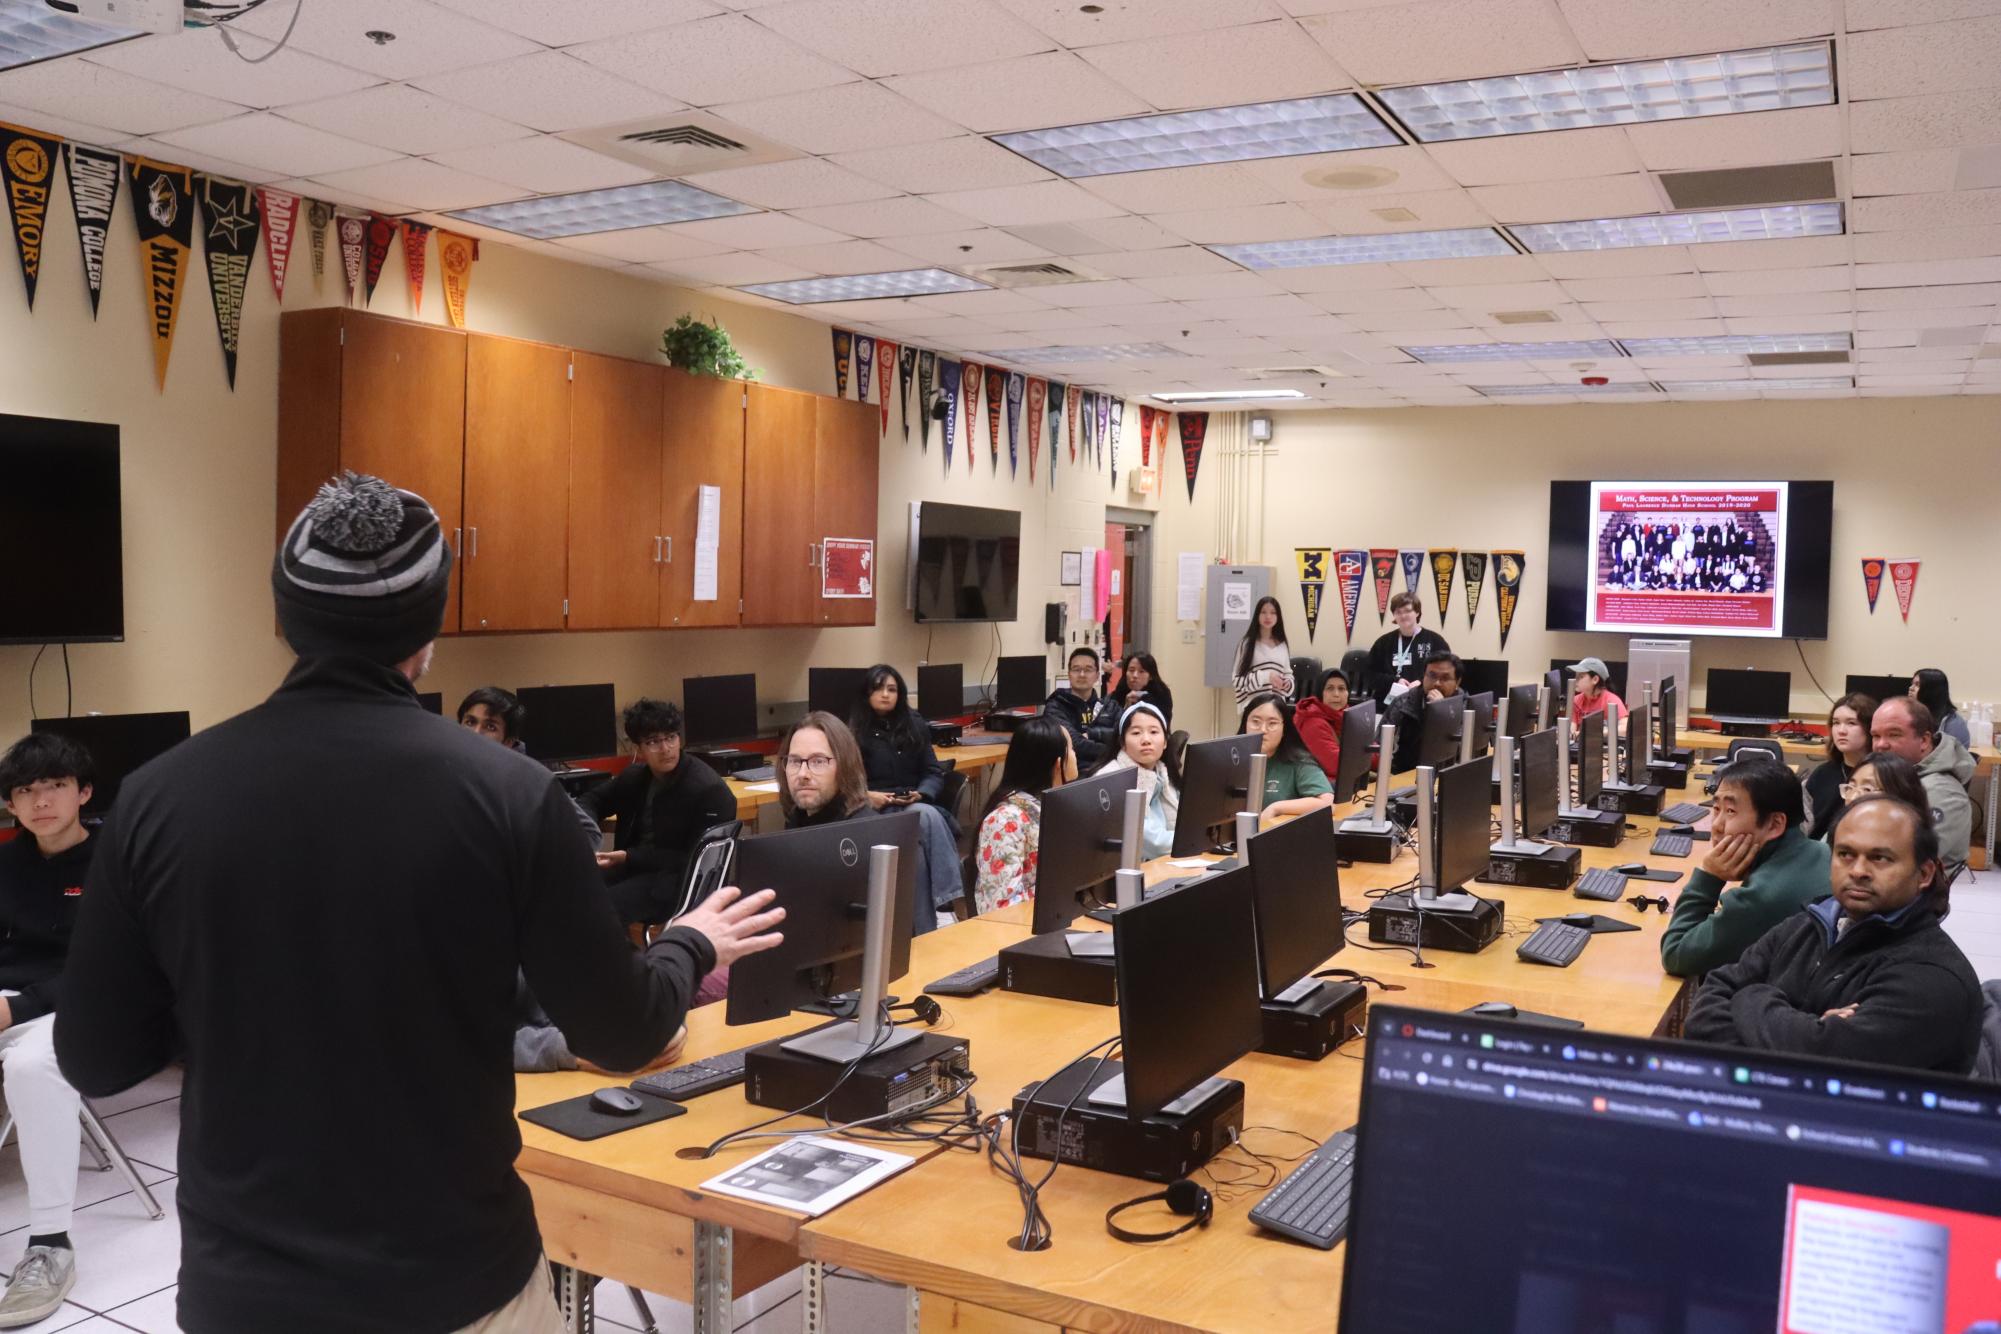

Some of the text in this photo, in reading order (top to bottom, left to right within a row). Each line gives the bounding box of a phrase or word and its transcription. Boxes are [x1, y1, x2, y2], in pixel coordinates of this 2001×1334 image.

[11, 180, 46, 280] EMORY
[68, 152, 118, 291] POMONA COLLEGE
[218, 215, 235, 230] V
[151, 242, 179, 339] MIZZOU
[209, 251, 233, 352] UNIVERSITY
[227, 254, 249, 353] VANDERBILT
[946, 393, 955, 445] OXFORD
[1671, 494, 1679, 503] &
[1726, 495, 1759, 503] PROGRAM
[1304, 552, 1322, 580] M
[1438, 573, 1450, 581] UC
[1307, 585, 1315, 618] MICHIGAN
[1340, 578, 1360, 627] AMERICAN
[1438, 582, 1450, 594] SAN
[1466, 580, 1480, 615] PURDUE
